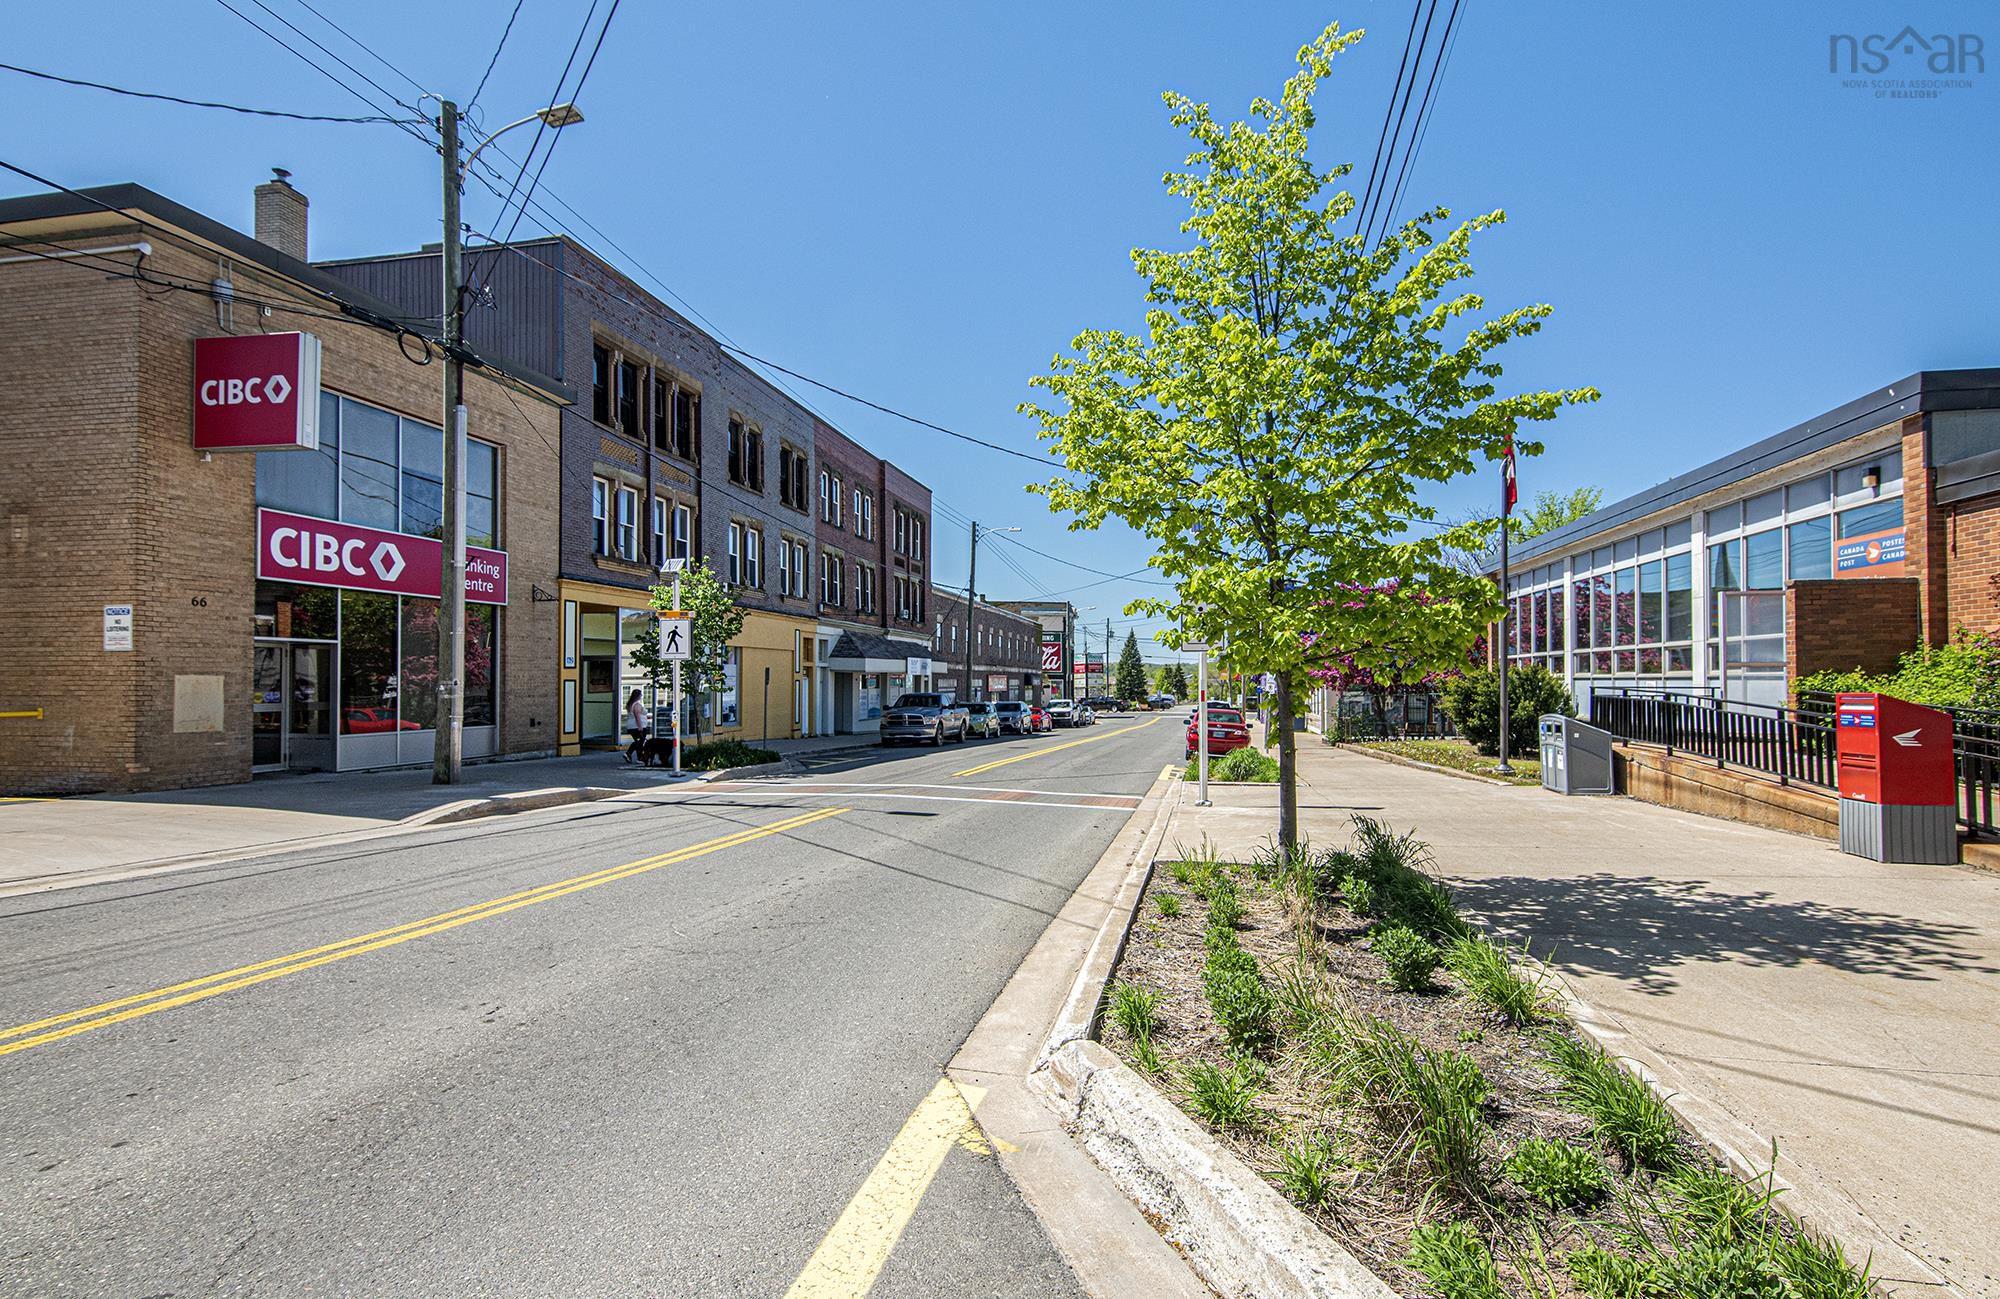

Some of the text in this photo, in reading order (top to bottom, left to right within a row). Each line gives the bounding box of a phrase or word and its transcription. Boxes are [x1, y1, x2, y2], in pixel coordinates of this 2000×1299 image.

[201, 377, 262, 406] CIBC
[269, 527, 367, 576] CIBC
[1839, 545, 1865, 556] CANADA
[1839, 559, 1855, 568] POST
[191, 596, 208, 607] 66
